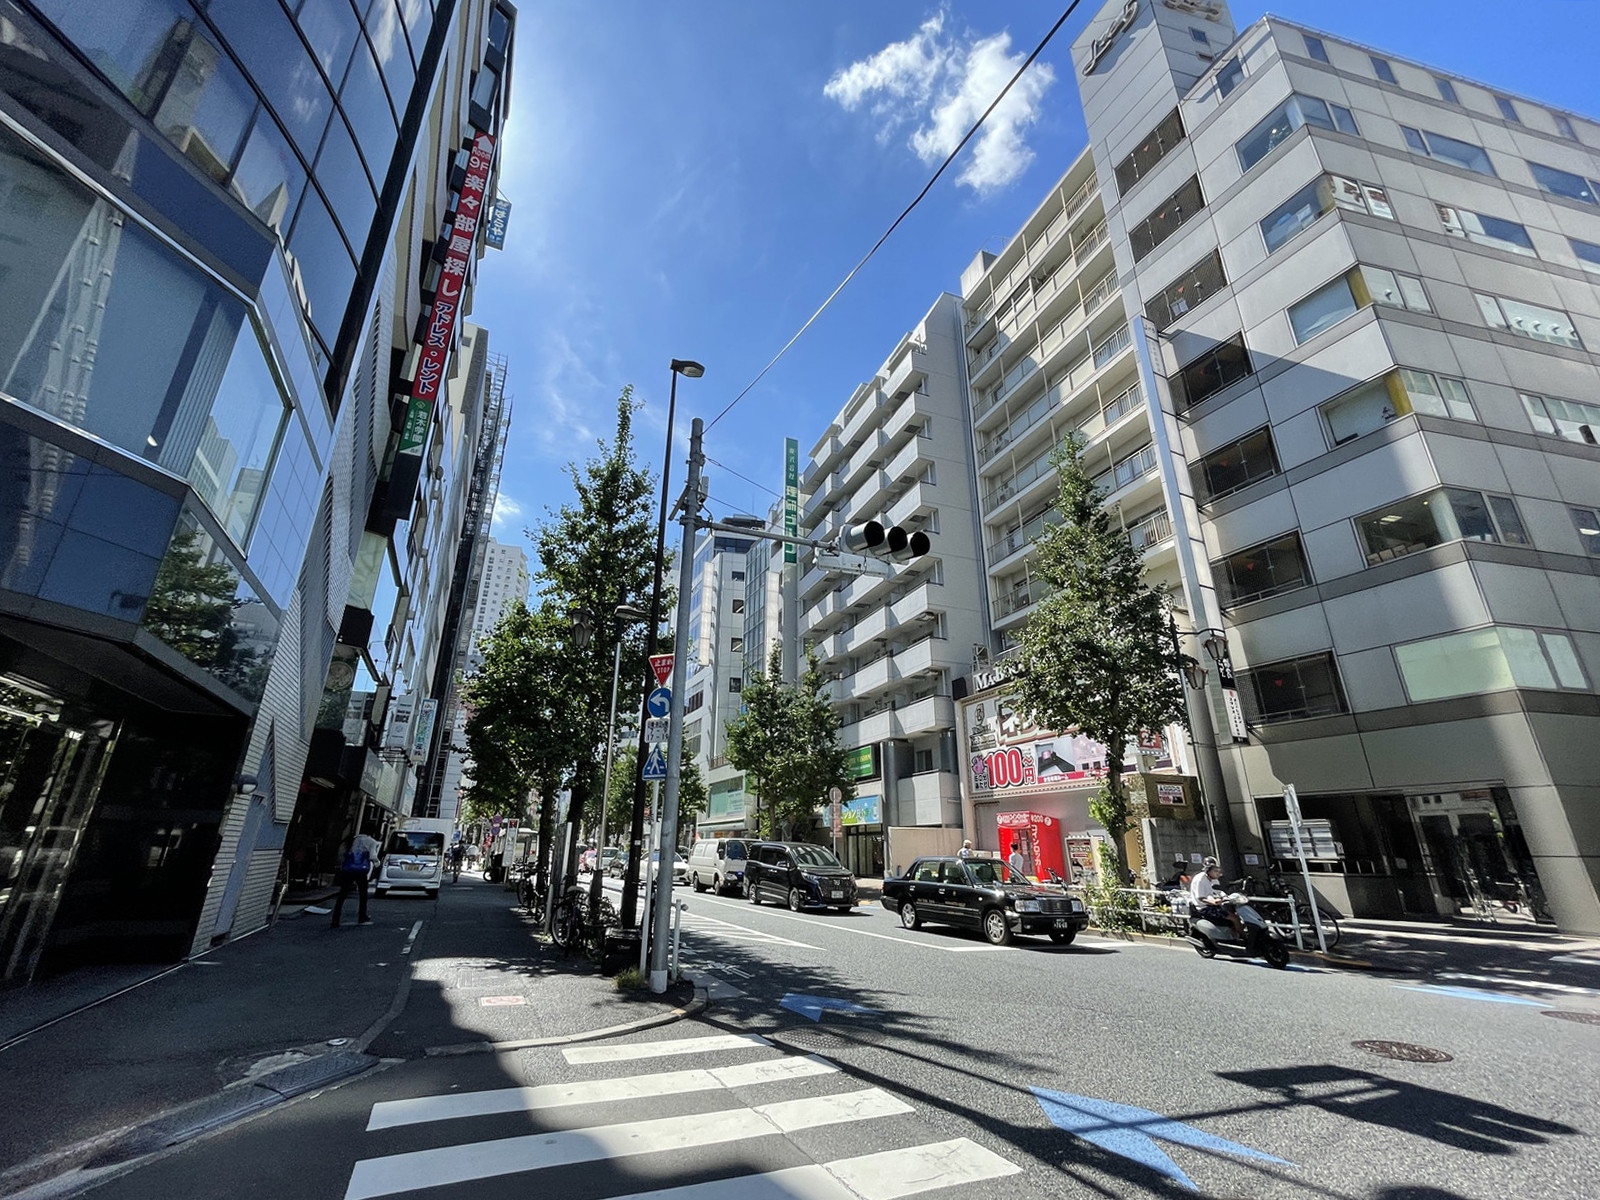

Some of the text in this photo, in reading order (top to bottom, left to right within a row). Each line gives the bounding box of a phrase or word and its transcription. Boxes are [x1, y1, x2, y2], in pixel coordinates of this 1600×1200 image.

[470, 156, 489, 171] 9F
[471, 146, 491, 161] Room
[442, 173, 485, 297] 楽々部屋探し
[419, 301, 453, 395] アドレス・レント
[654, 658, 673, 667] 止まれ
[985, 748, 1022, 787] 100
[1030, 824, 1042, 873] コインロッカー
